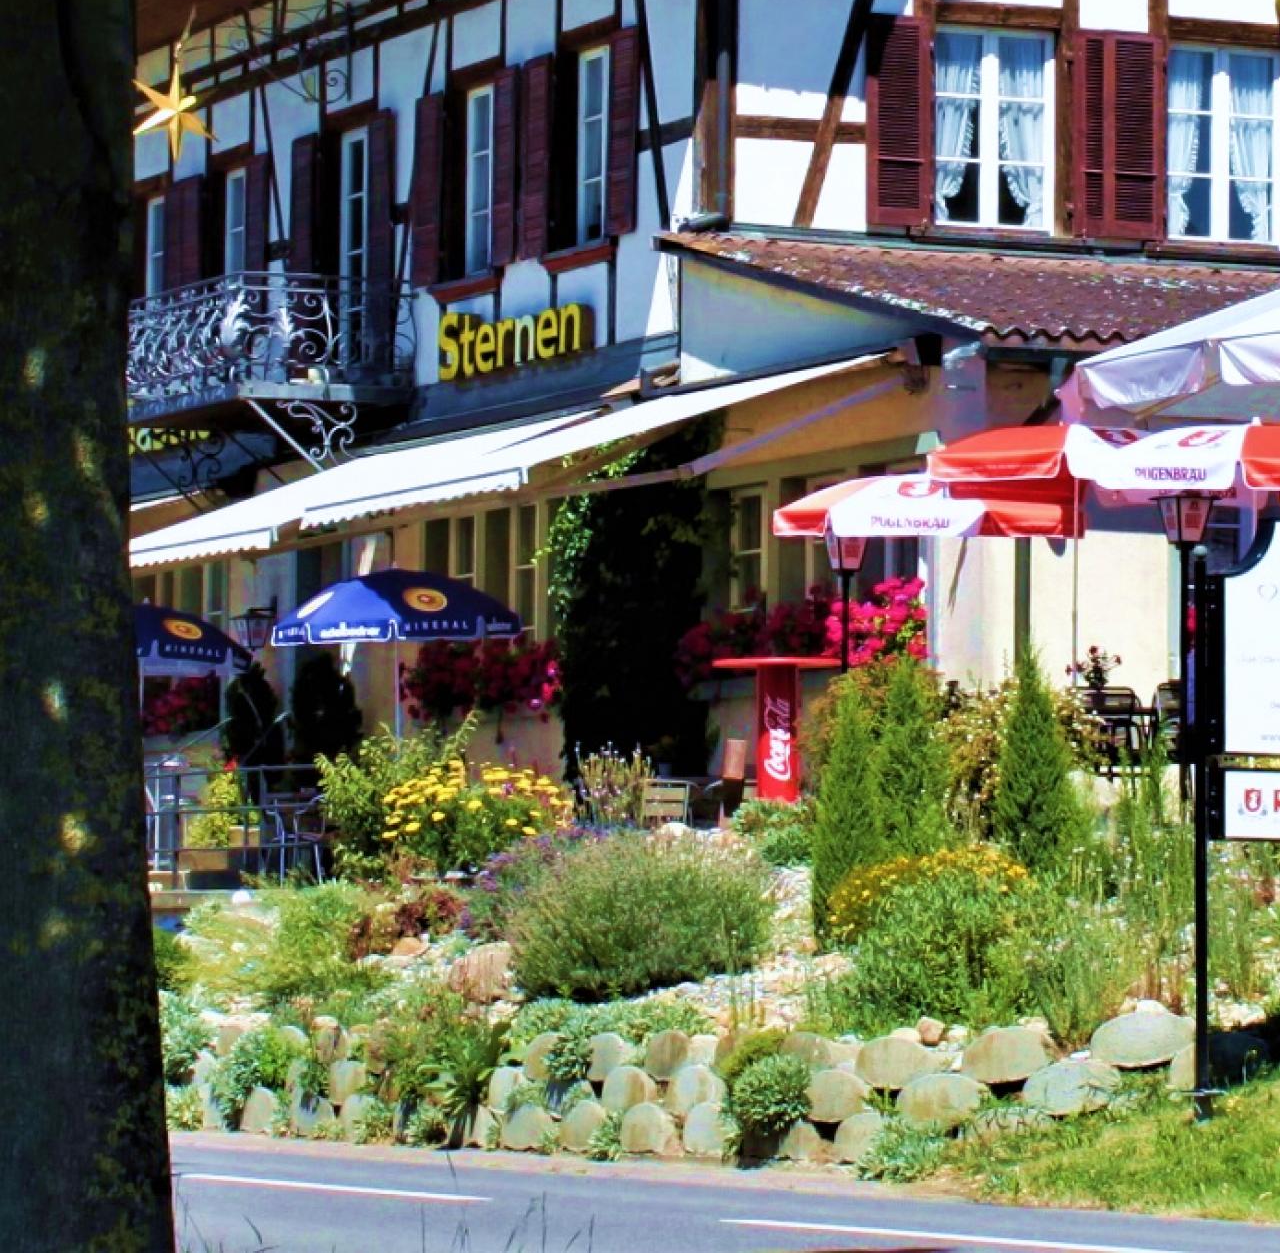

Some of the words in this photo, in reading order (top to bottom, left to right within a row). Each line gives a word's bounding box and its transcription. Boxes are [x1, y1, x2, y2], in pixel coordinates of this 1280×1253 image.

[438, 302, 584, 381] Sternen
[405, 620, 469, 632] MINERAL
[164, 643, 221, 658] MINERAL
